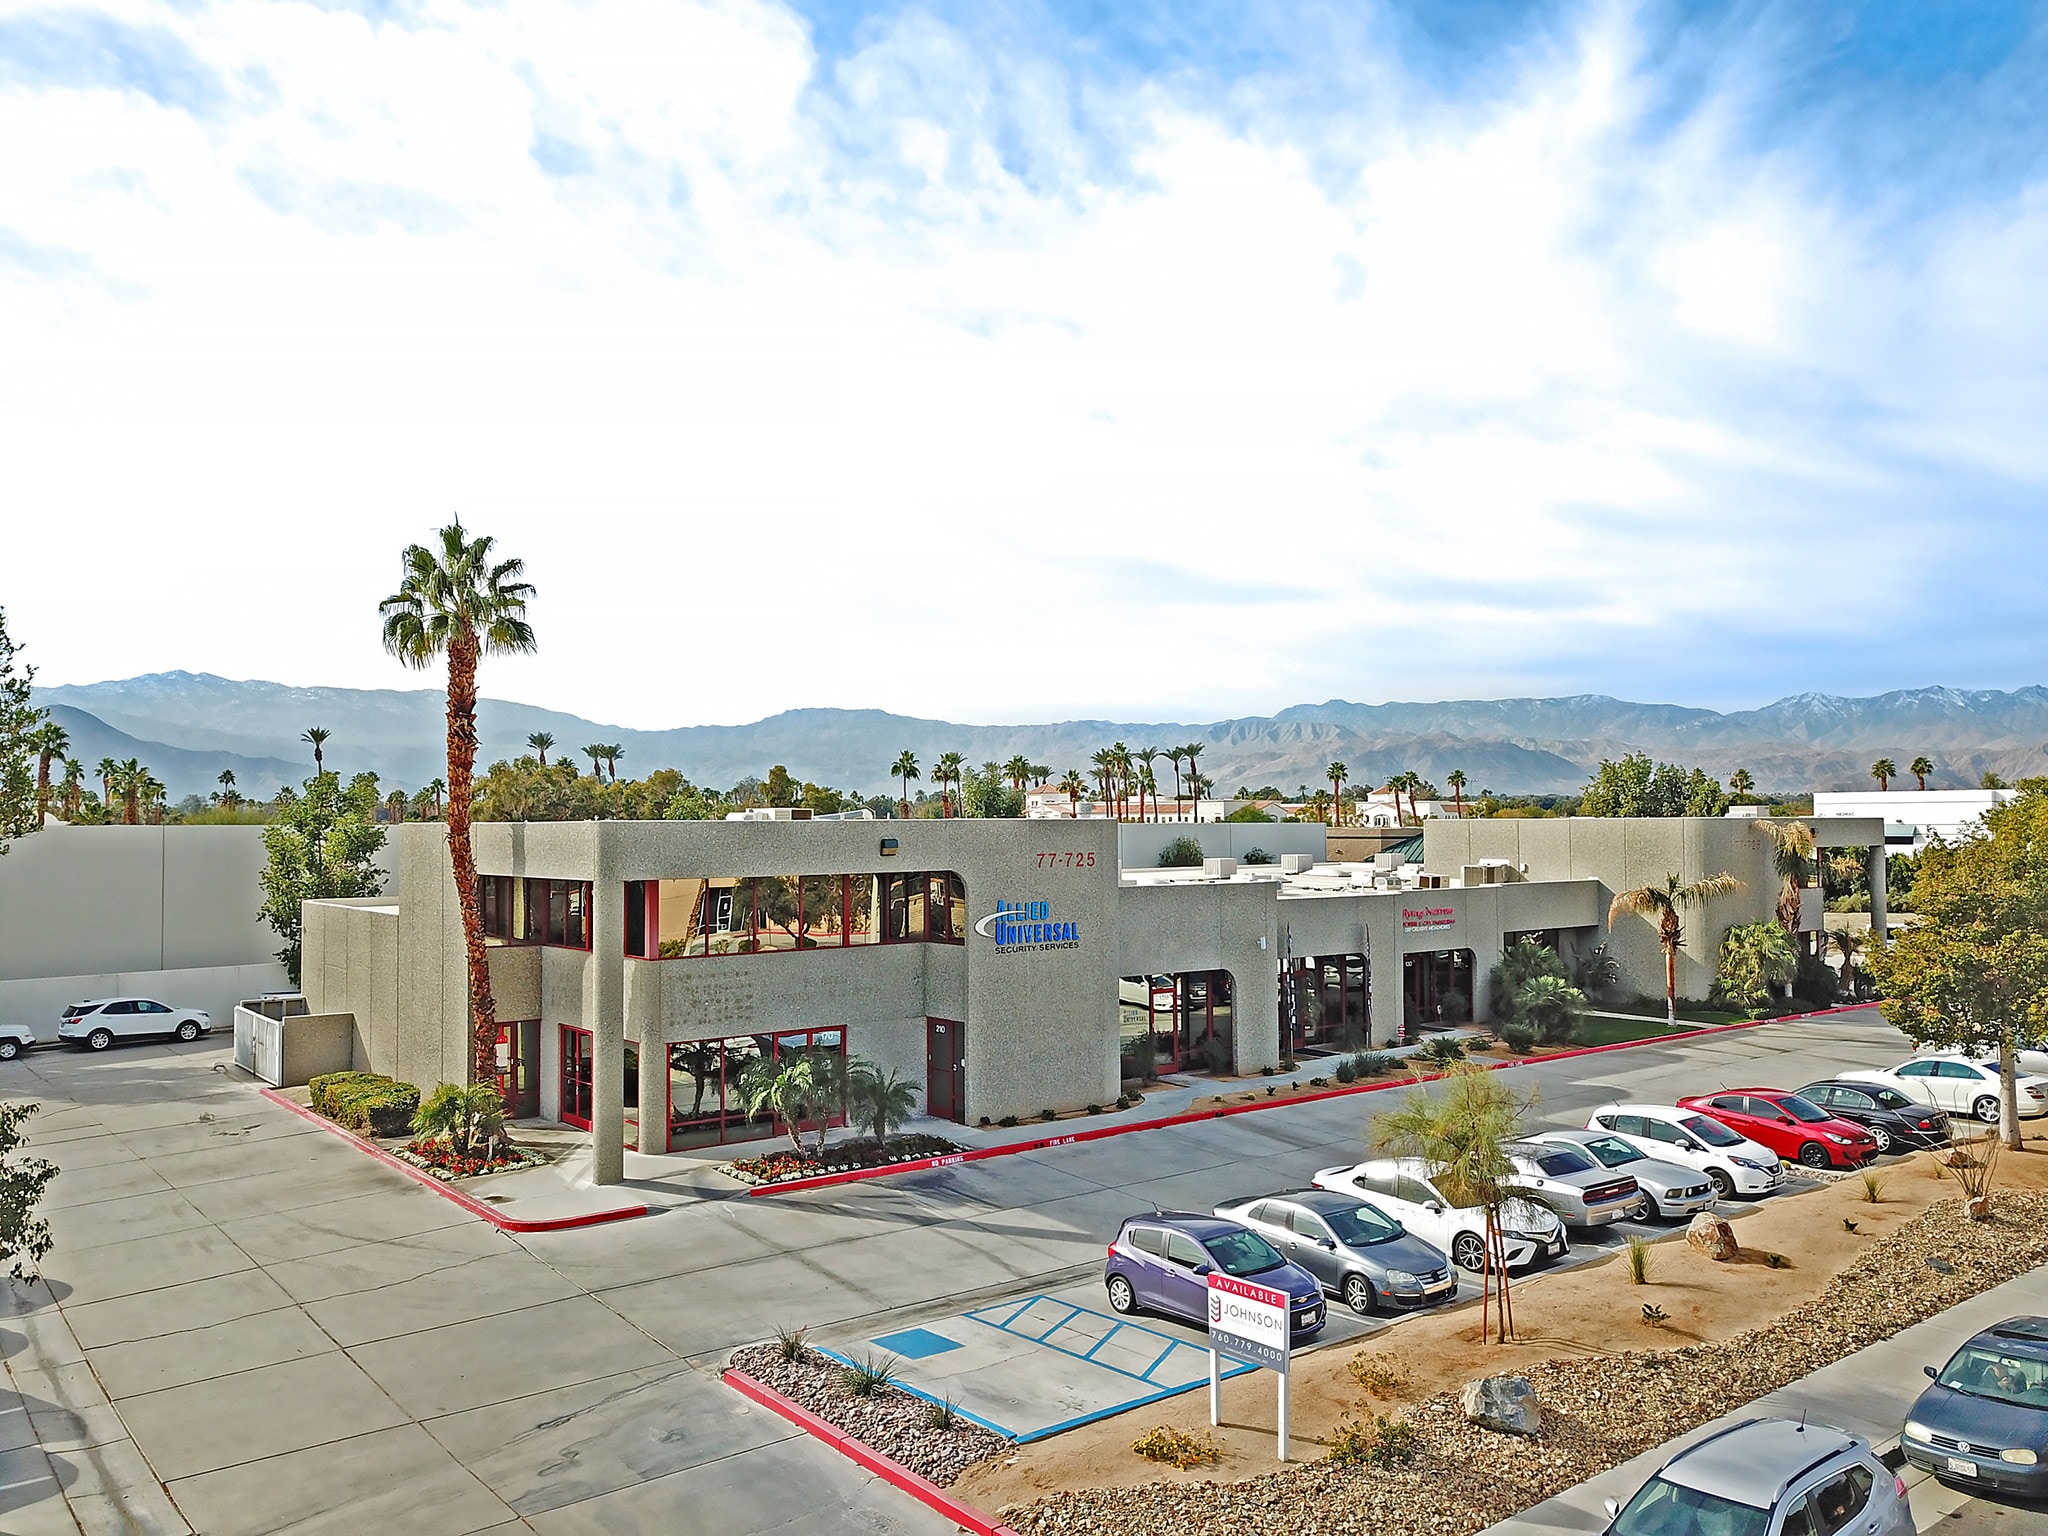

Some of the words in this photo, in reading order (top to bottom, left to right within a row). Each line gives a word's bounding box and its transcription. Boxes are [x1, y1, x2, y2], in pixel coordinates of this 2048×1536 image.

[1036, 851, 1096, 868] 77-725
[996, 899, 1050, 923] ALLIED
[994, 920, 1080, 946] UNIVERSAL
[994, 944, 1039, 956] SECURITY
[1039, 941, 1080, 953] SERVICES
[941, 1155, 965, 1166] PARKING
[1216, 1278, 1277, 1305] AVAILABLE
[1223, 1303, 1283, 1331] JOHNSON
[1211, 1330, 1282, 1362] 760.779.4000
